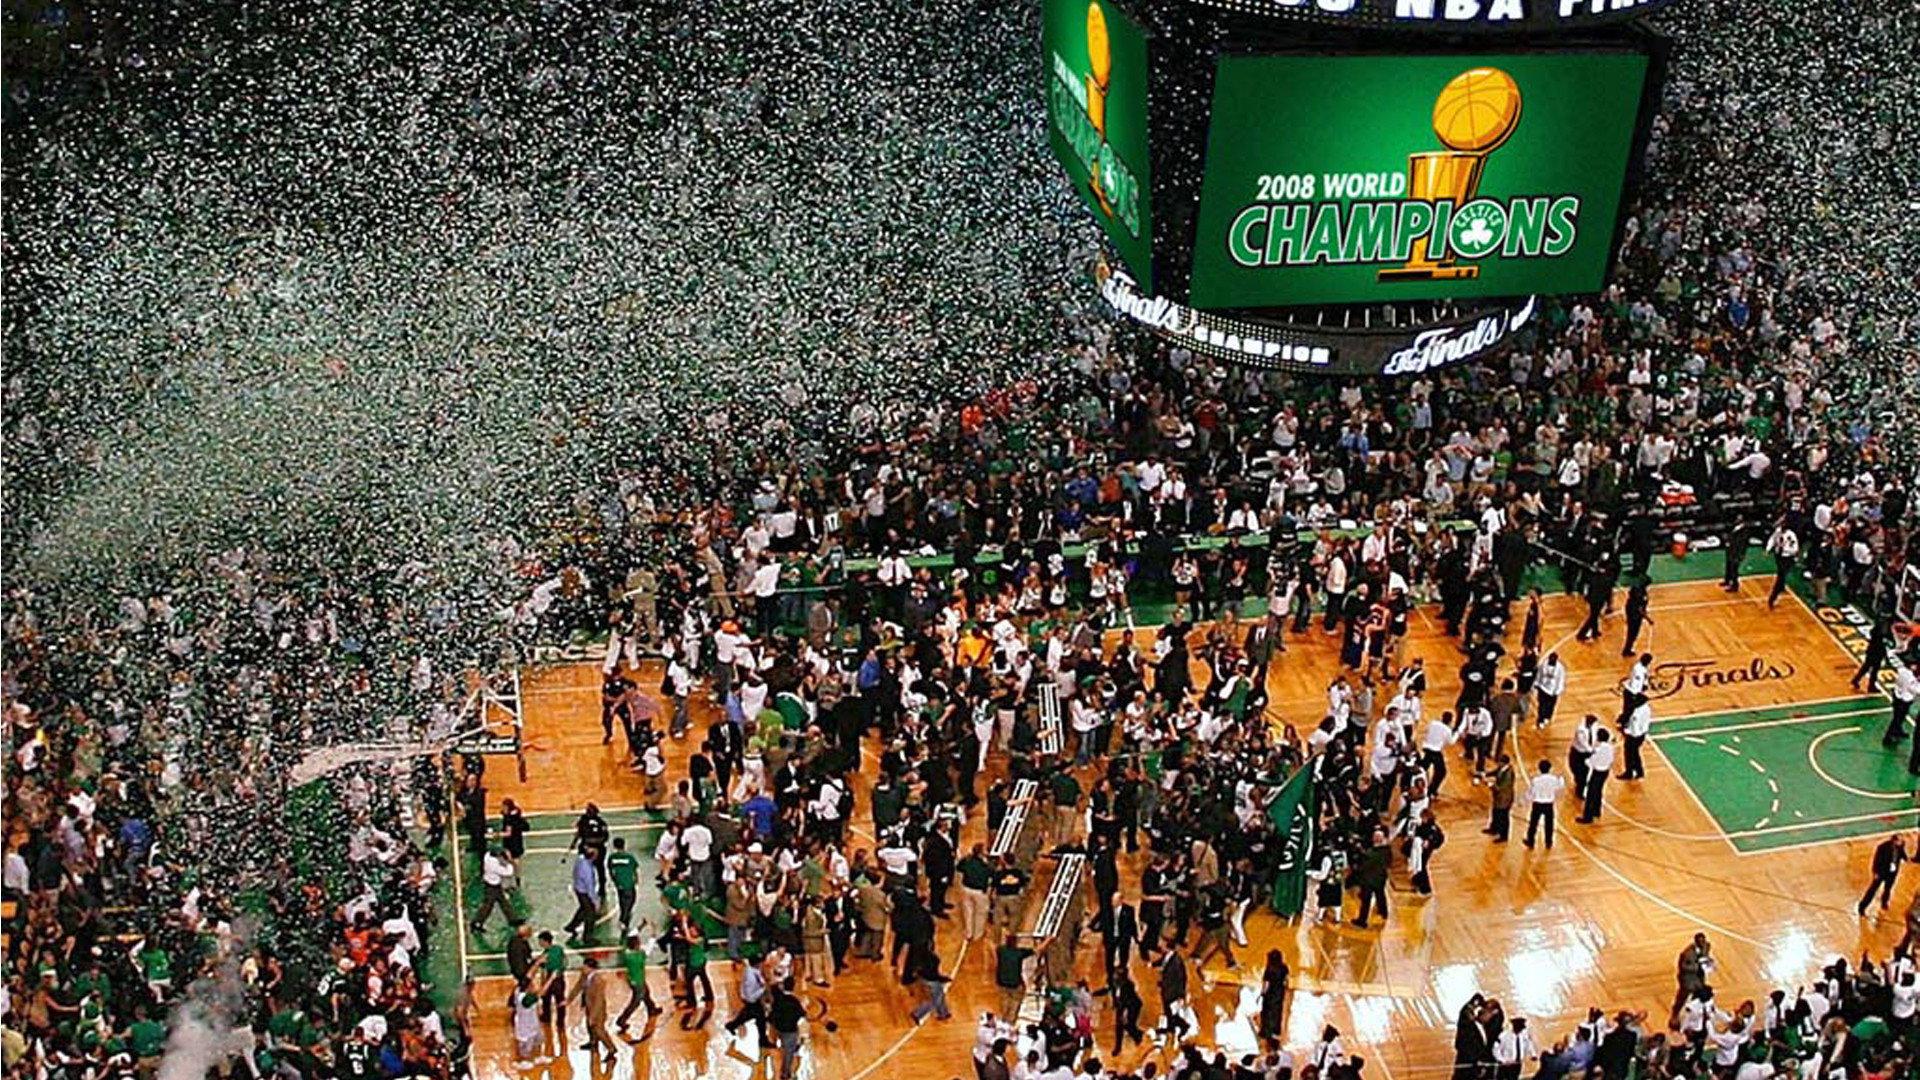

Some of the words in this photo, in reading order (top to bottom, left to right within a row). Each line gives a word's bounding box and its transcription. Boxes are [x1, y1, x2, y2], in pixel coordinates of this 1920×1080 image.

[1256, 175, 1315, 201] 2008
[1323, 172, 1405, 198] WORLD
[1228, 197, 1580, 267] CHAMPIONS
[1414, 308, 1509, 373] Finals
[1645, 657, 1796, 699] Finals
